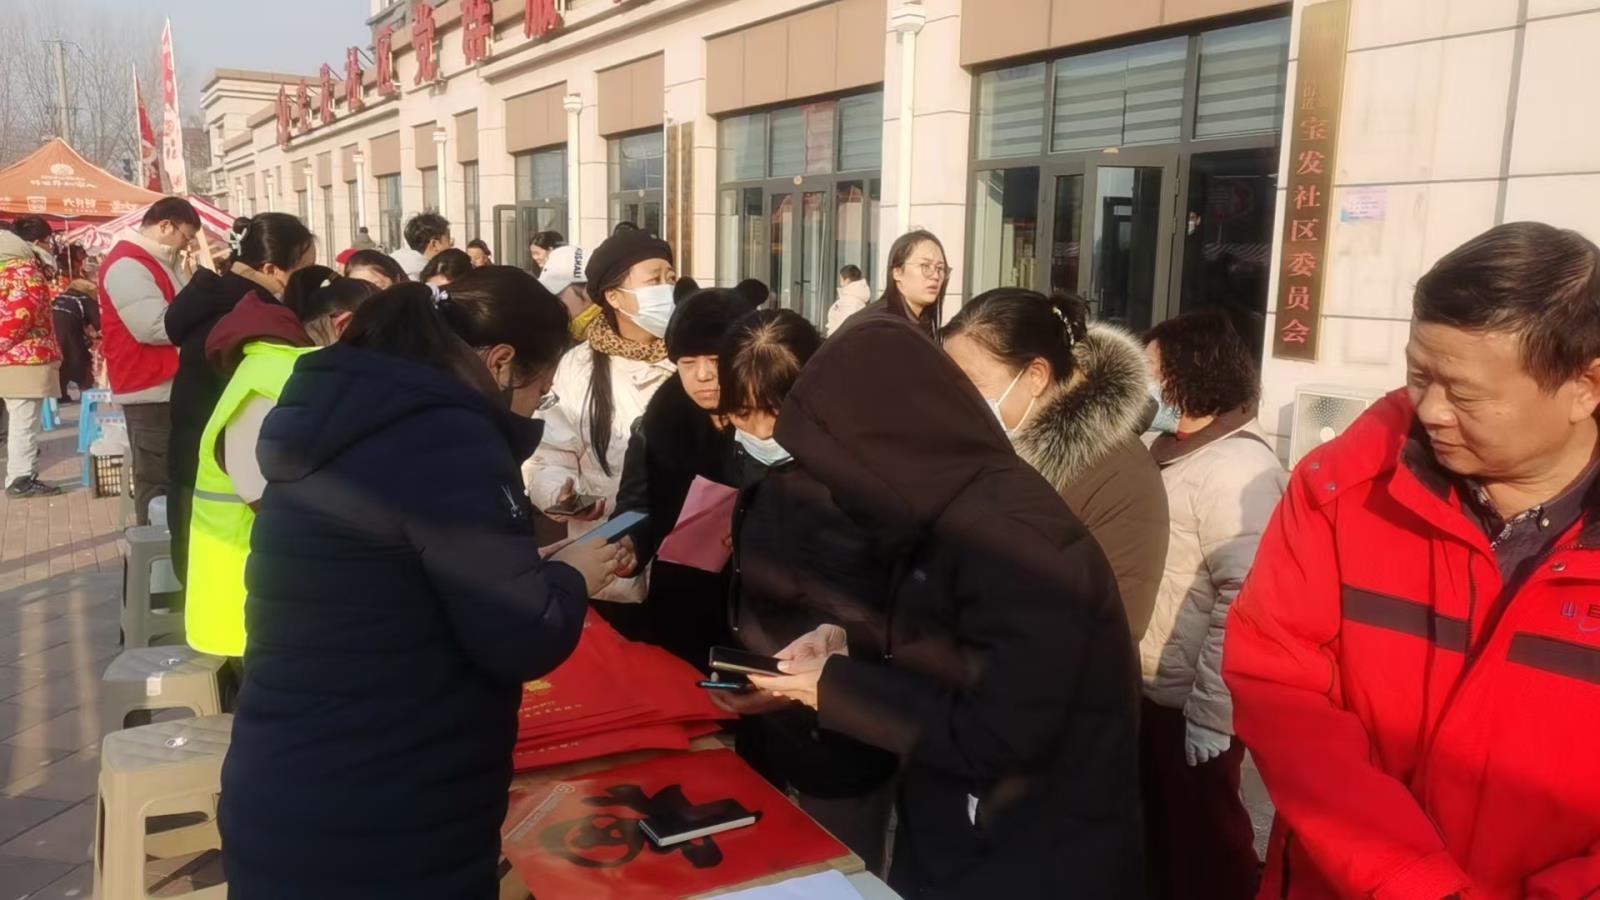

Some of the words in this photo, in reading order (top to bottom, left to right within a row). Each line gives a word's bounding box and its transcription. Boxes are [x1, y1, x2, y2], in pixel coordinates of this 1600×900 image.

[1281, 117, 1329, 344] 宝发社区委员会
